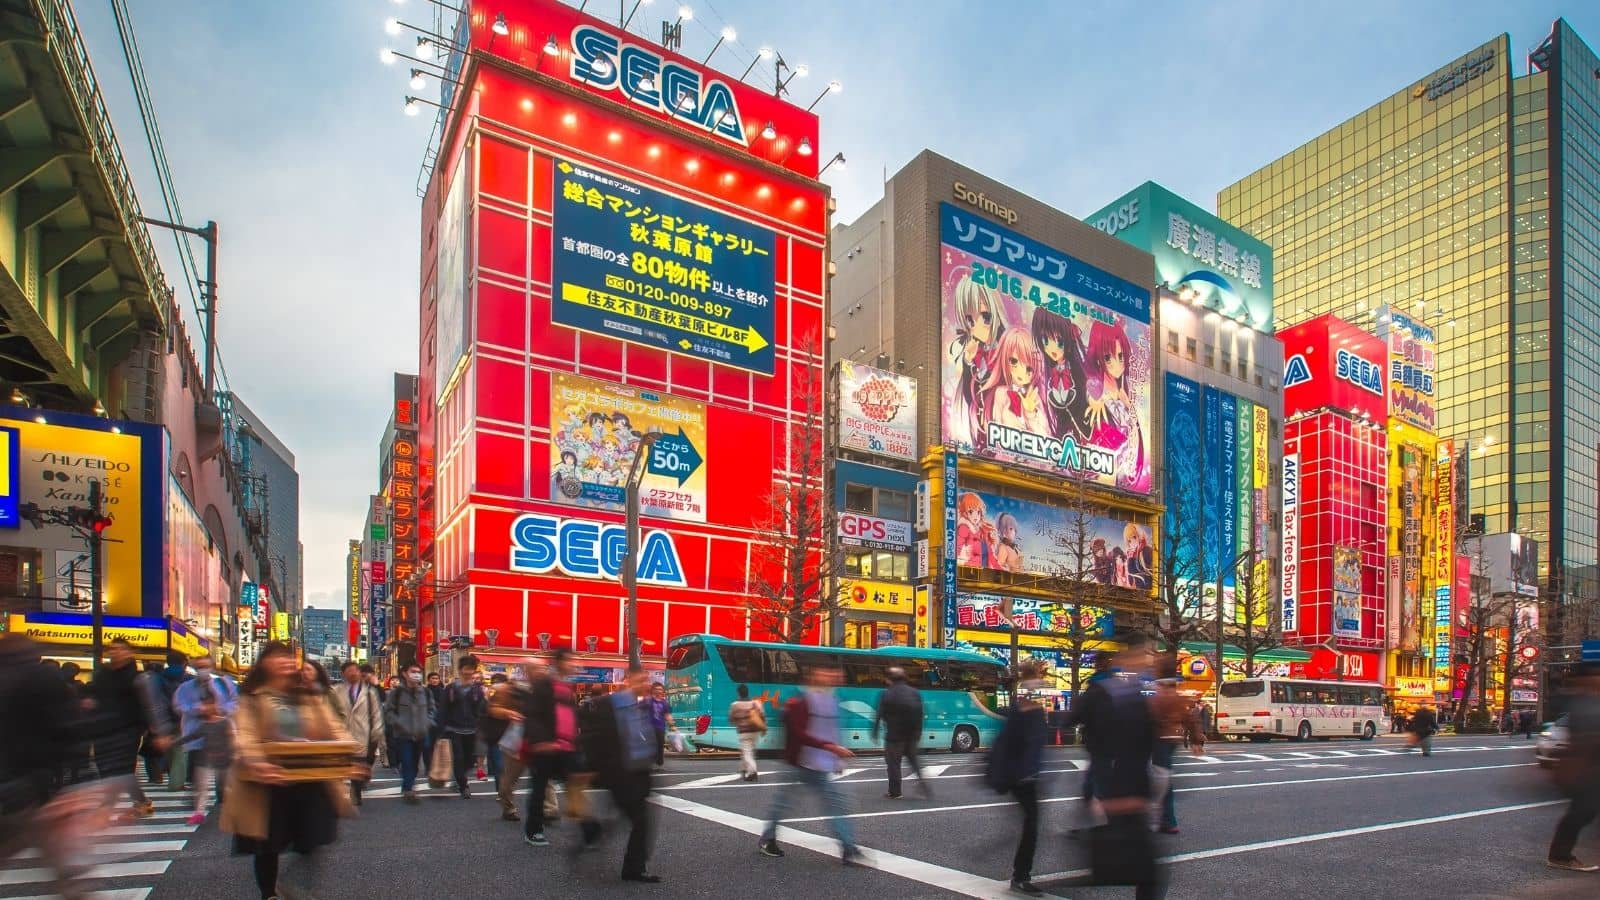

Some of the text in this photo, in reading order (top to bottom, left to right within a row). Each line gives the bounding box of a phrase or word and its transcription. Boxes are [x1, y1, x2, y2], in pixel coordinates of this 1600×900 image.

[570, 25, 749, 147] SEGA
[562, 180, 769, 256] 総合マンションギャラリー
[954, 181, 1018, 225] Sofmap
[630, 222, 714, 264] 秋葉原館
[952, 214, 1069, 280] ソフマップ
[1166, 212, 1262, 289] 廣瀬無線
[626, 279, 733, 319] 0120-009-897
[1336, 348, 1384, 396] SEGA
[653, 440, 689, 453] ここから
[863, 422, 891, 435] APPLE
[32, 452, 131, 473] SHISEIDO
[653, 451, 691, 472] 50m
[1284, 458, 1296, 497] AKKY
[45, 487, 120, 505] Kanbo
[648, 488, 692, 503] クラブセガ
[840, 514, 886, 541] GPS
[1284, 507, 1297, 563] Tax-free
[394, 460, 414, 642] 東京ラジオデパート
[510, 513, 689, 588] SEGA
[873, 590, 899, 605] 松屋
[1283, 565, 1297, 597] Shop
[26, 628, 97, 640] Matsumot
[1288, 706, 1357, 719] YUNAGI
